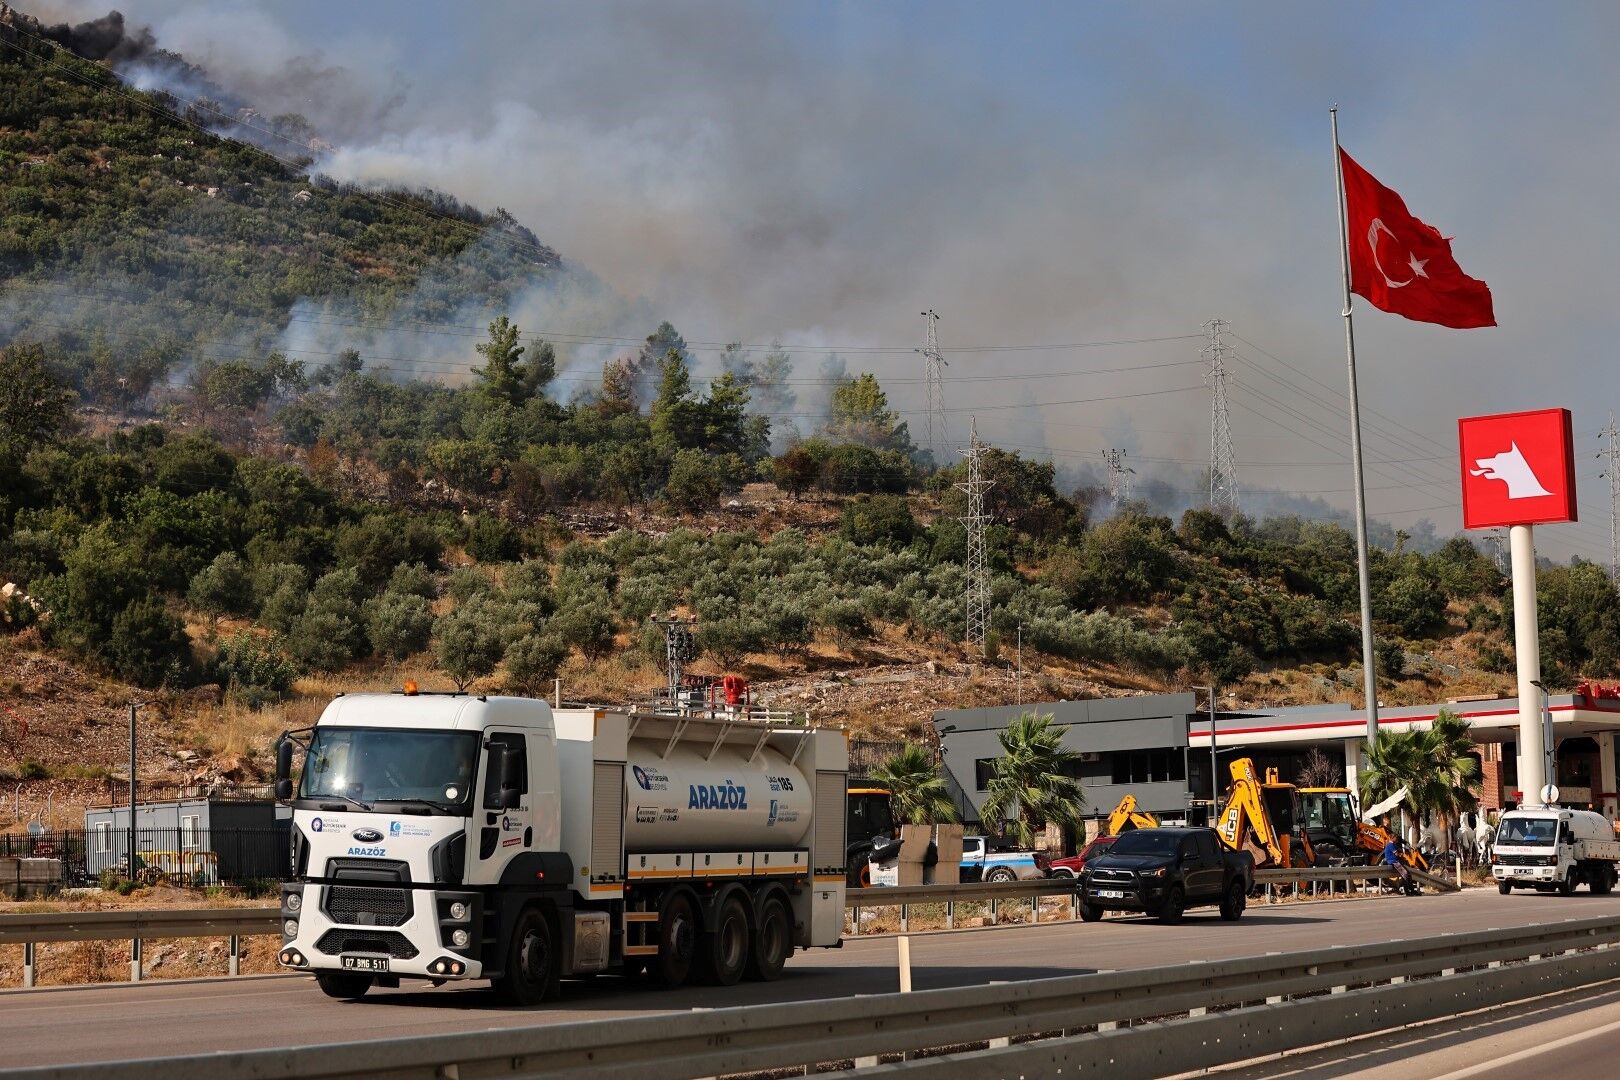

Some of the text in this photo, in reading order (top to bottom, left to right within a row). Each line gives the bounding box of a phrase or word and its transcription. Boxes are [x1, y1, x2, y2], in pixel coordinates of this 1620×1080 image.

[777, 776, 794, 792] 185
[688, 779, 748, 810] ARAZÖZ
[1225, 808, 1238, 842] JCB
[1363, 829, 1380, 840] JCB
[347, 846, 386, 857] ARAZÖZ
[345, 958, 354, 967] 07
[373, 960, 386, 969] 511
